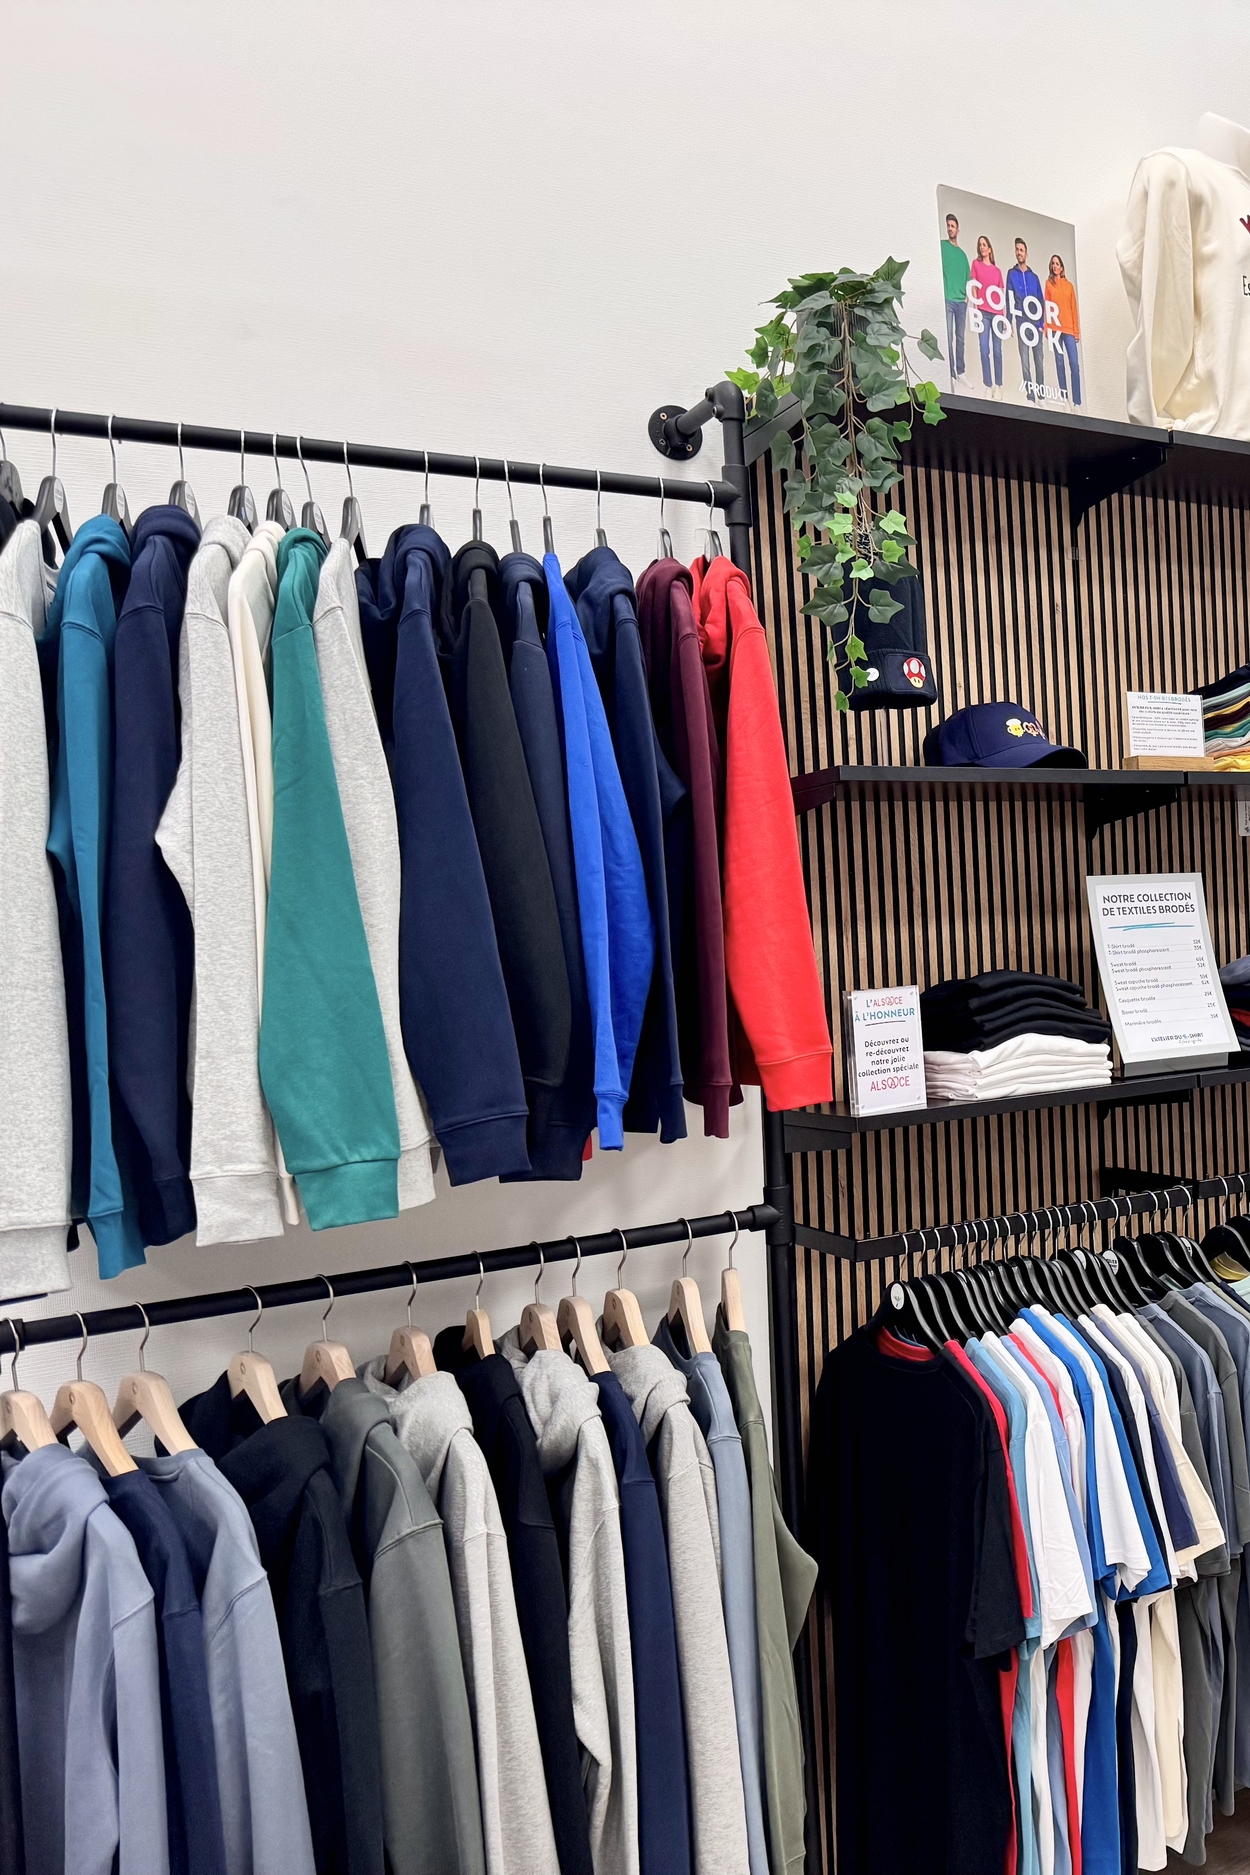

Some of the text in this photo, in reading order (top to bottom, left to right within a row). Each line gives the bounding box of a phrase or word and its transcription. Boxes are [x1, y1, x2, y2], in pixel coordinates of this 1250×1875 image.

[965, 279, 1062, 327] COLOR
[968, 307, 1064, 355] BOOK
[1102, 892, 1192, 904] NOTRE COLLECTION
[1102, 902, 1196, 917] DE TEXTILES BRODÉS
[854, 1007, 915, 1022] À L'HONNEUR
[864, 1037, 899, 1048] Découvrez
[865, 1046, 910, 1057] re-découvrez
[871, 1055, 906, 1066] notre jolie
[858, 1063, 920, 1078] collection spéciale
[870, 1075, 910, 1092] ALSACE
